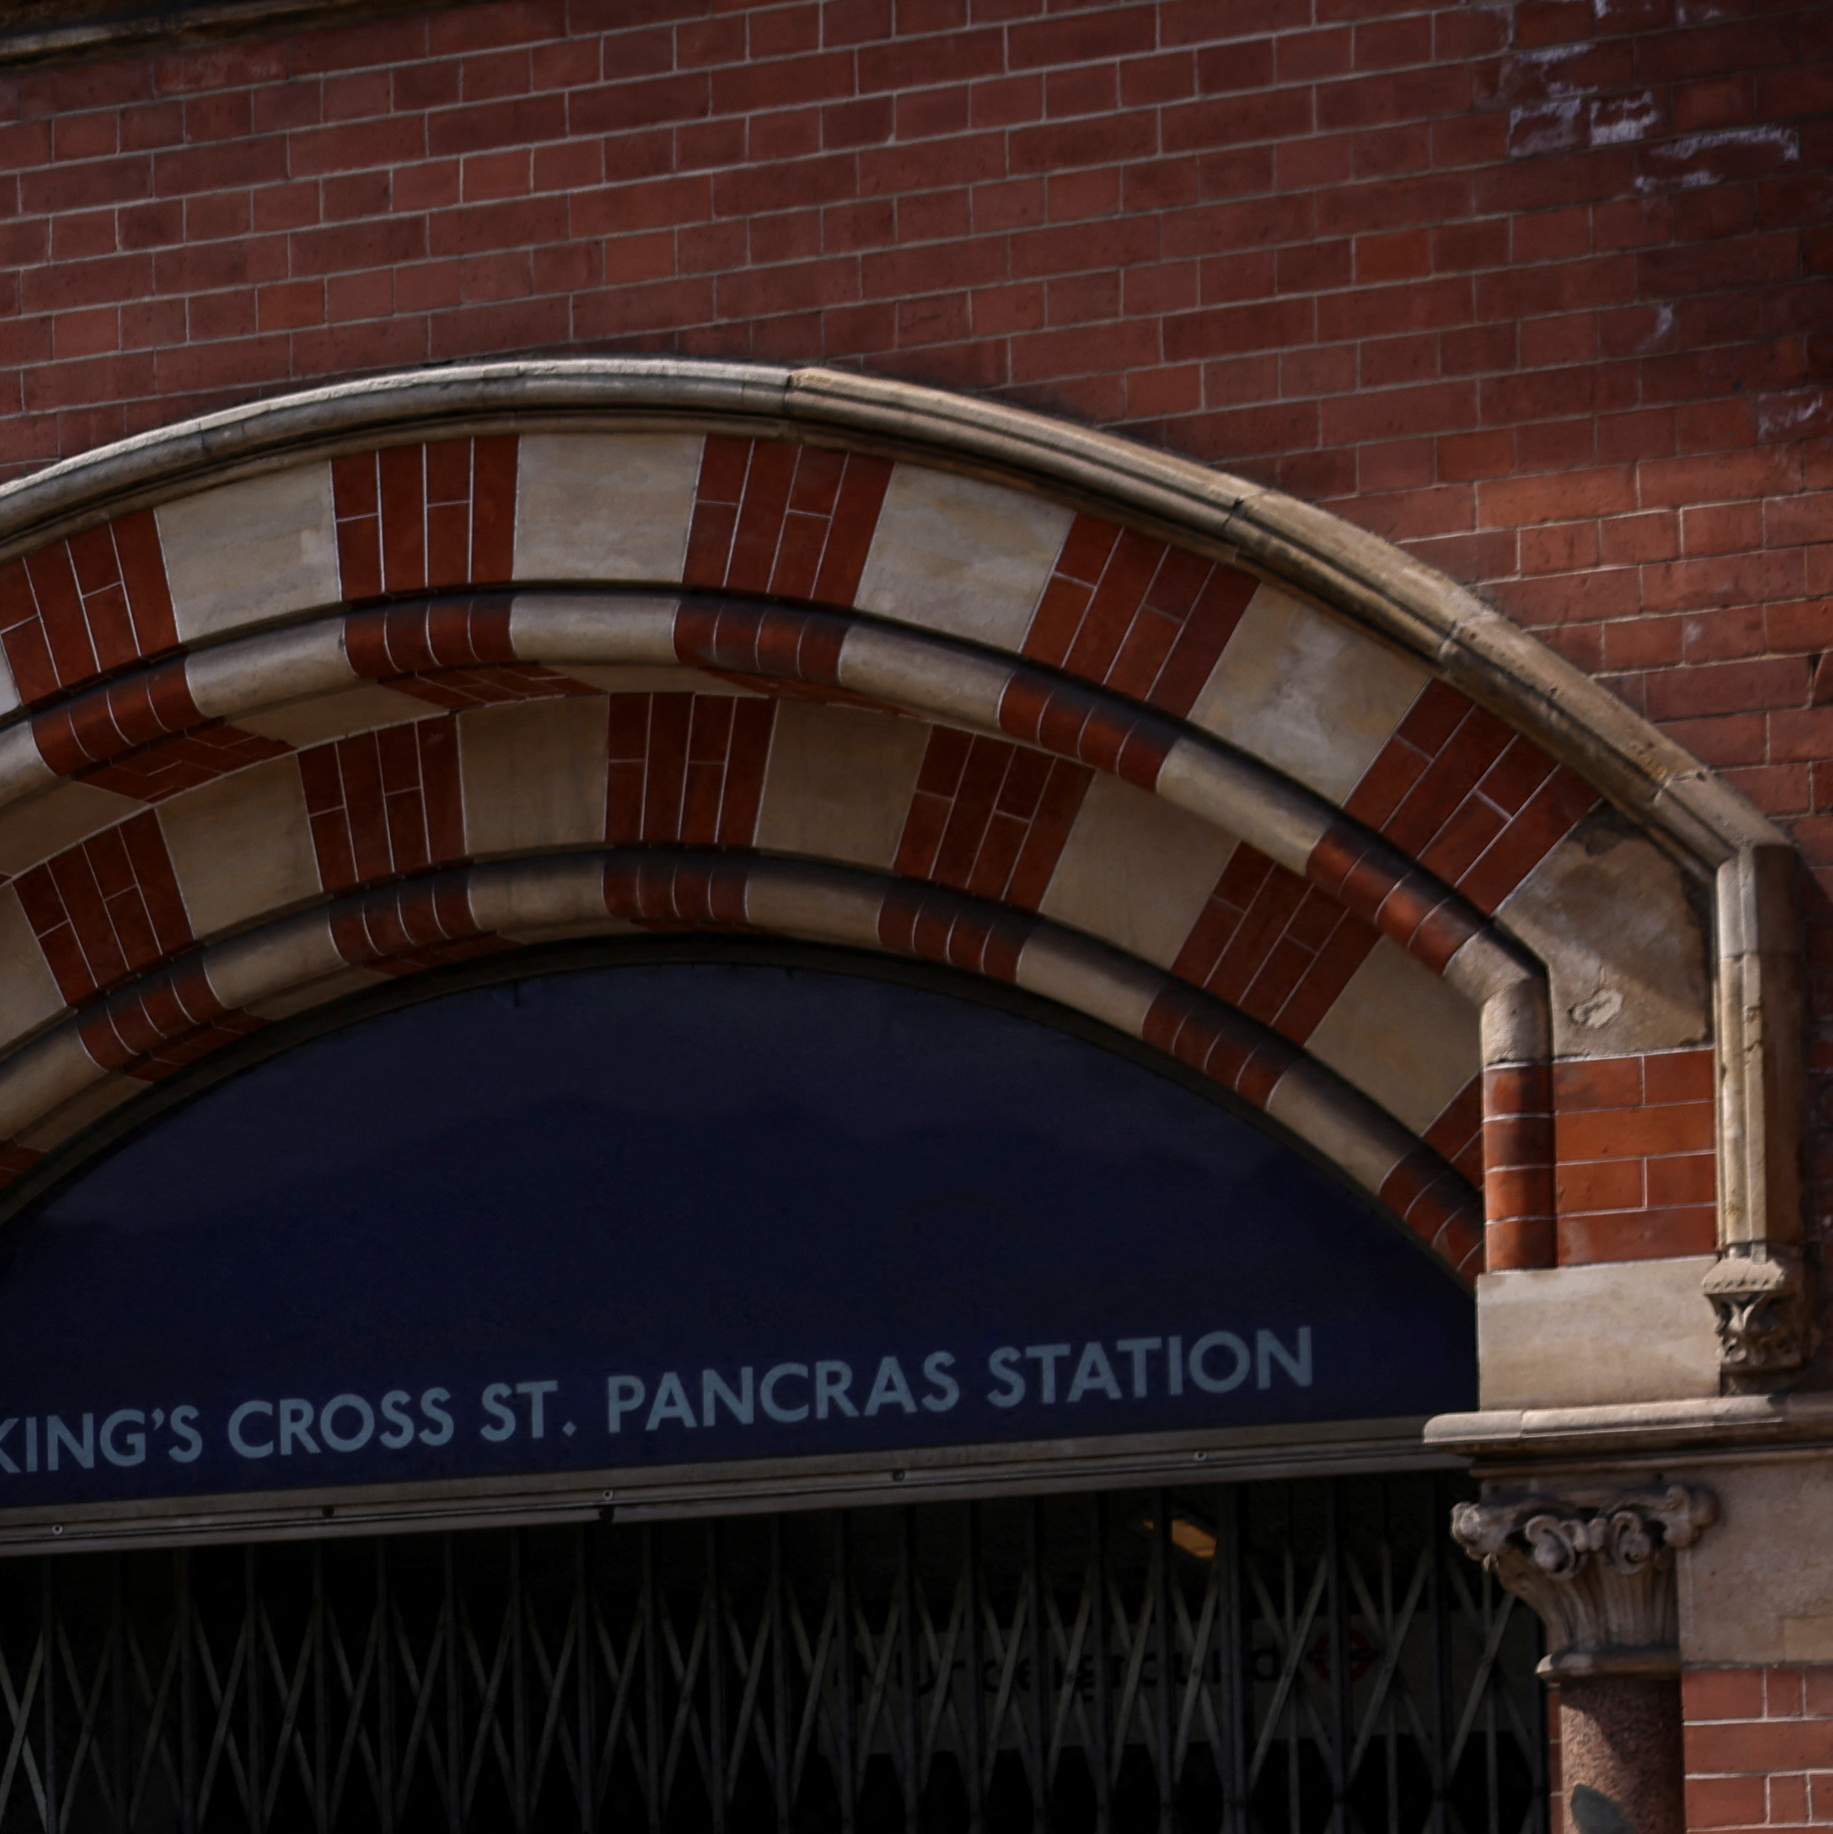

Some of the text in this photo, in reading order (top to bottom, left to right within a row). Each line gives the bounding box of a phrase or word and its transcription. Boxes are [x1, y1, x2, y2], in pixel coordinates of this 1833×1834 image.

[226, 1387, 455, 1459] CROSS
[480, 1380, 578, 1442] ST.
[607, 1351, 961, 1434] PANCRAS
[987, 1327, 1312, 1408] STATION
